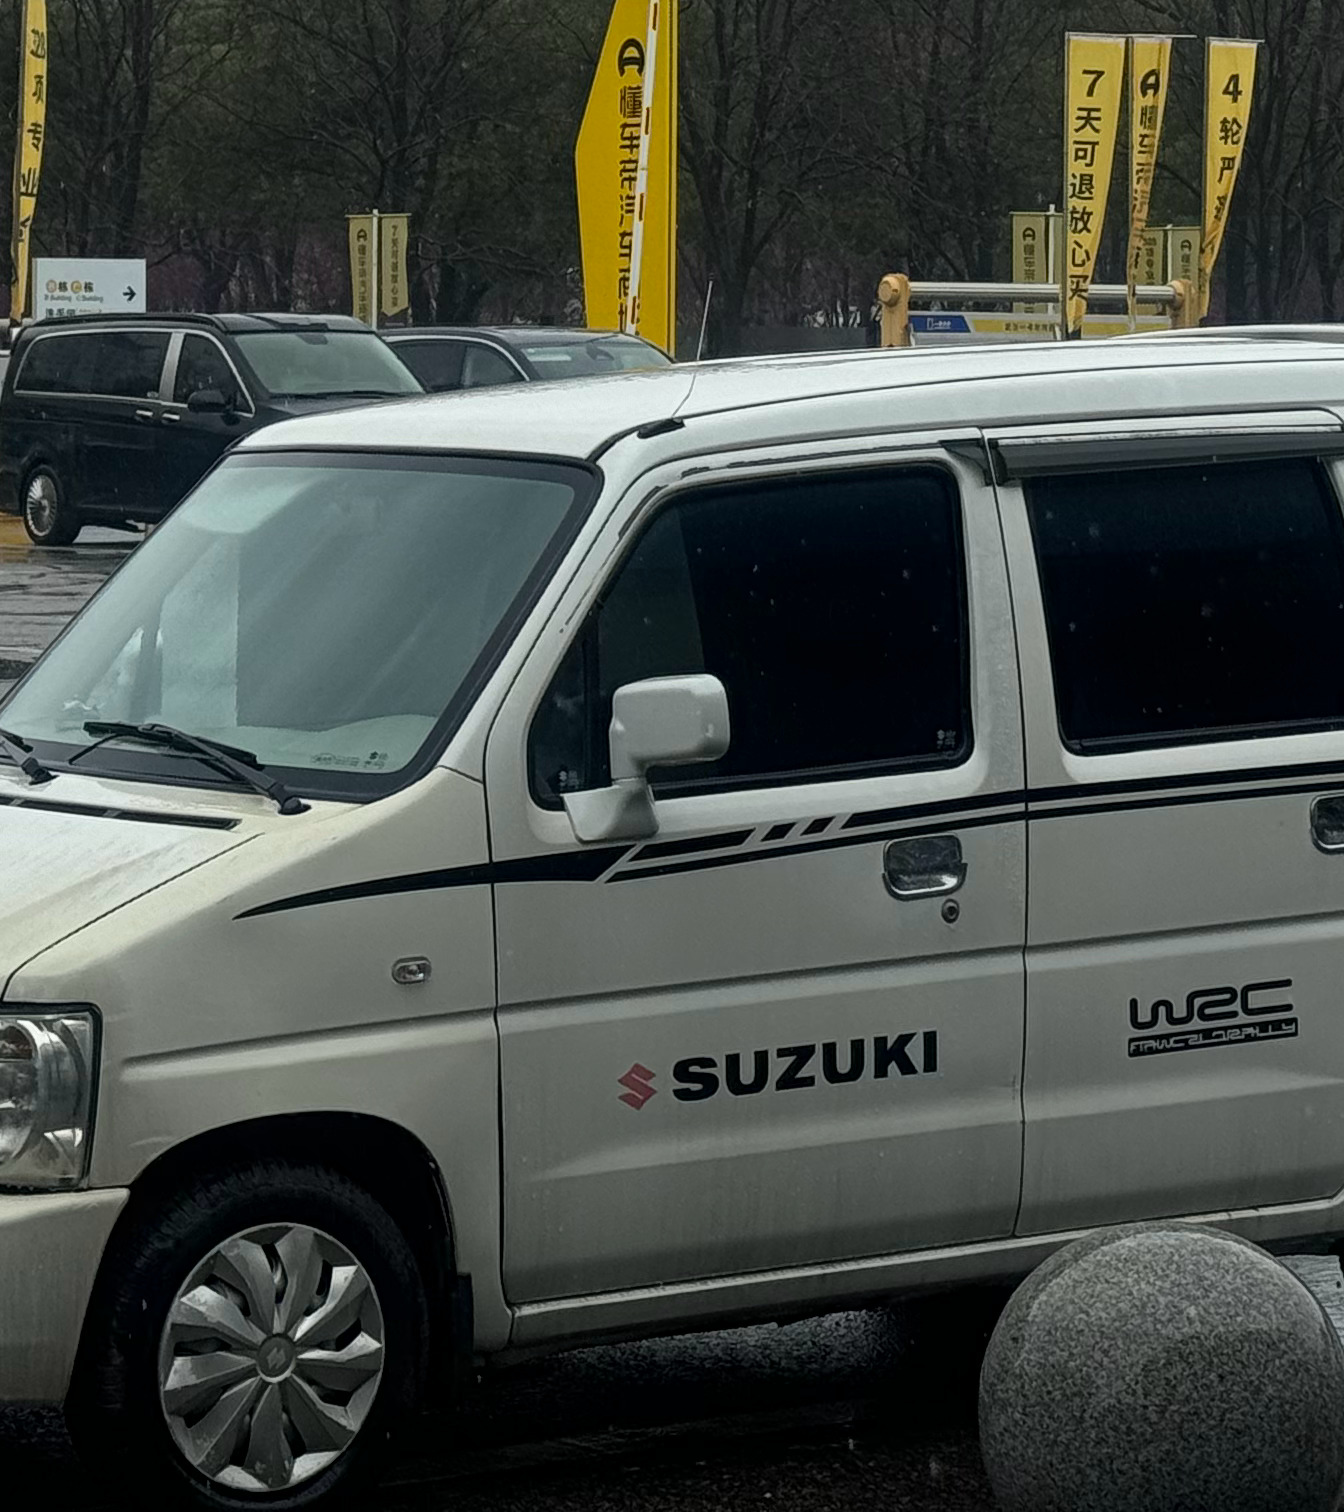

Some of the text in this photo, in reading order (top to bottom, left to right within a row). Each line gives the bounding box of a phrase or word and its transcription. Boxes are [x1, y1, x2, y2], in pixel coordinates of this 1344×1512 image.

[1069, 69, 1105, 301] 7天可退放心买
[1129, 978, 1294, 1030] WRC
[672, 1029, 938, 1102] SUZUKI
